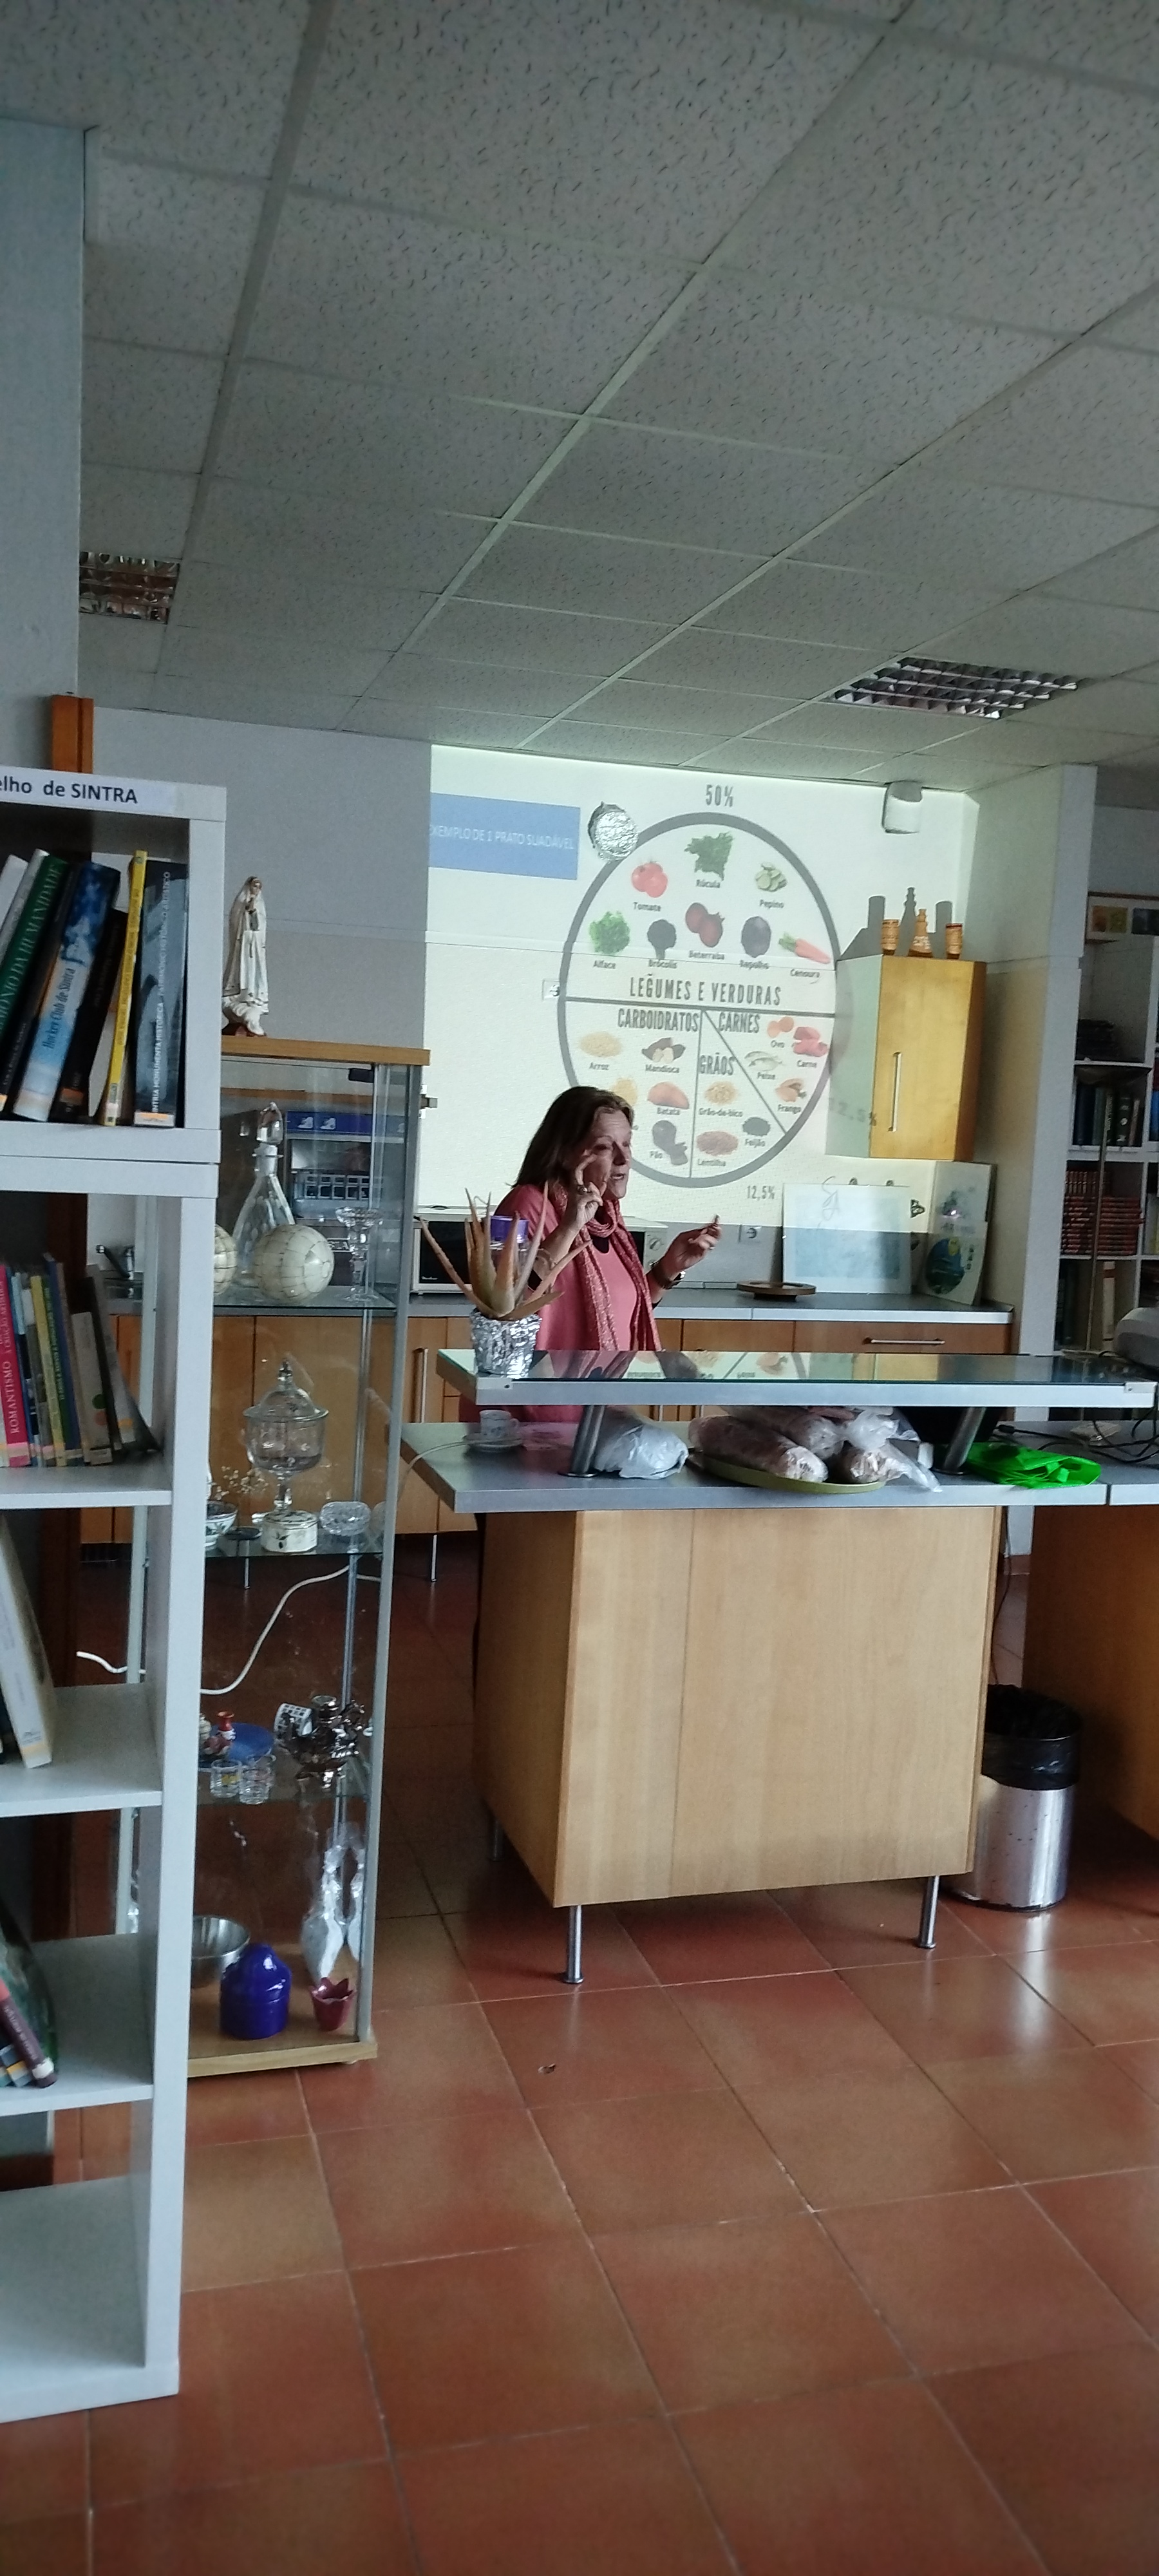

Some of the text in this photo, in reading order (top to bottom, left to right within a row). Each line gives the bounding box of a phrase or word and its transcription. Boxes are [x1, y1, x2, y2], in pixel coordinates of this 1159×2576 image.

[0, 775, 138, 804] lho de SINTRA
[705, 784, 734, 807] 50%
[429, 824, 471, 840] XEMPLO
[473, 829, 485, 841] DE
[495, 831, 524, 845] PRATO
[634, 902, 661, 912] Tomate
[759, 899, 784, 909] Pepino
[592, 960, 616, 969] Alface
[790, 969, 820, 978] Cenoura
[58, 968, 76, 992] Sintra
[629, 976, 782, 1006] LEGUMES E VERDURAS
[617, 1008, 700, 1032] CARBOIDRATOS
[718, 1011, 761, 1034] CARNES
[771, 1040, 785, 1048] Ovo
[589, 1062, 610, 1070] Arroz
[645, 1064, 680, 1074] Mandioca
[700, 1052, 735, 1075] GRÃOS
[796, 1060, 817, 1068] Carne
[747, 1185, 775, 1201] 12,5%
[3, 1361, 20, 1434] ROMANTISMO
